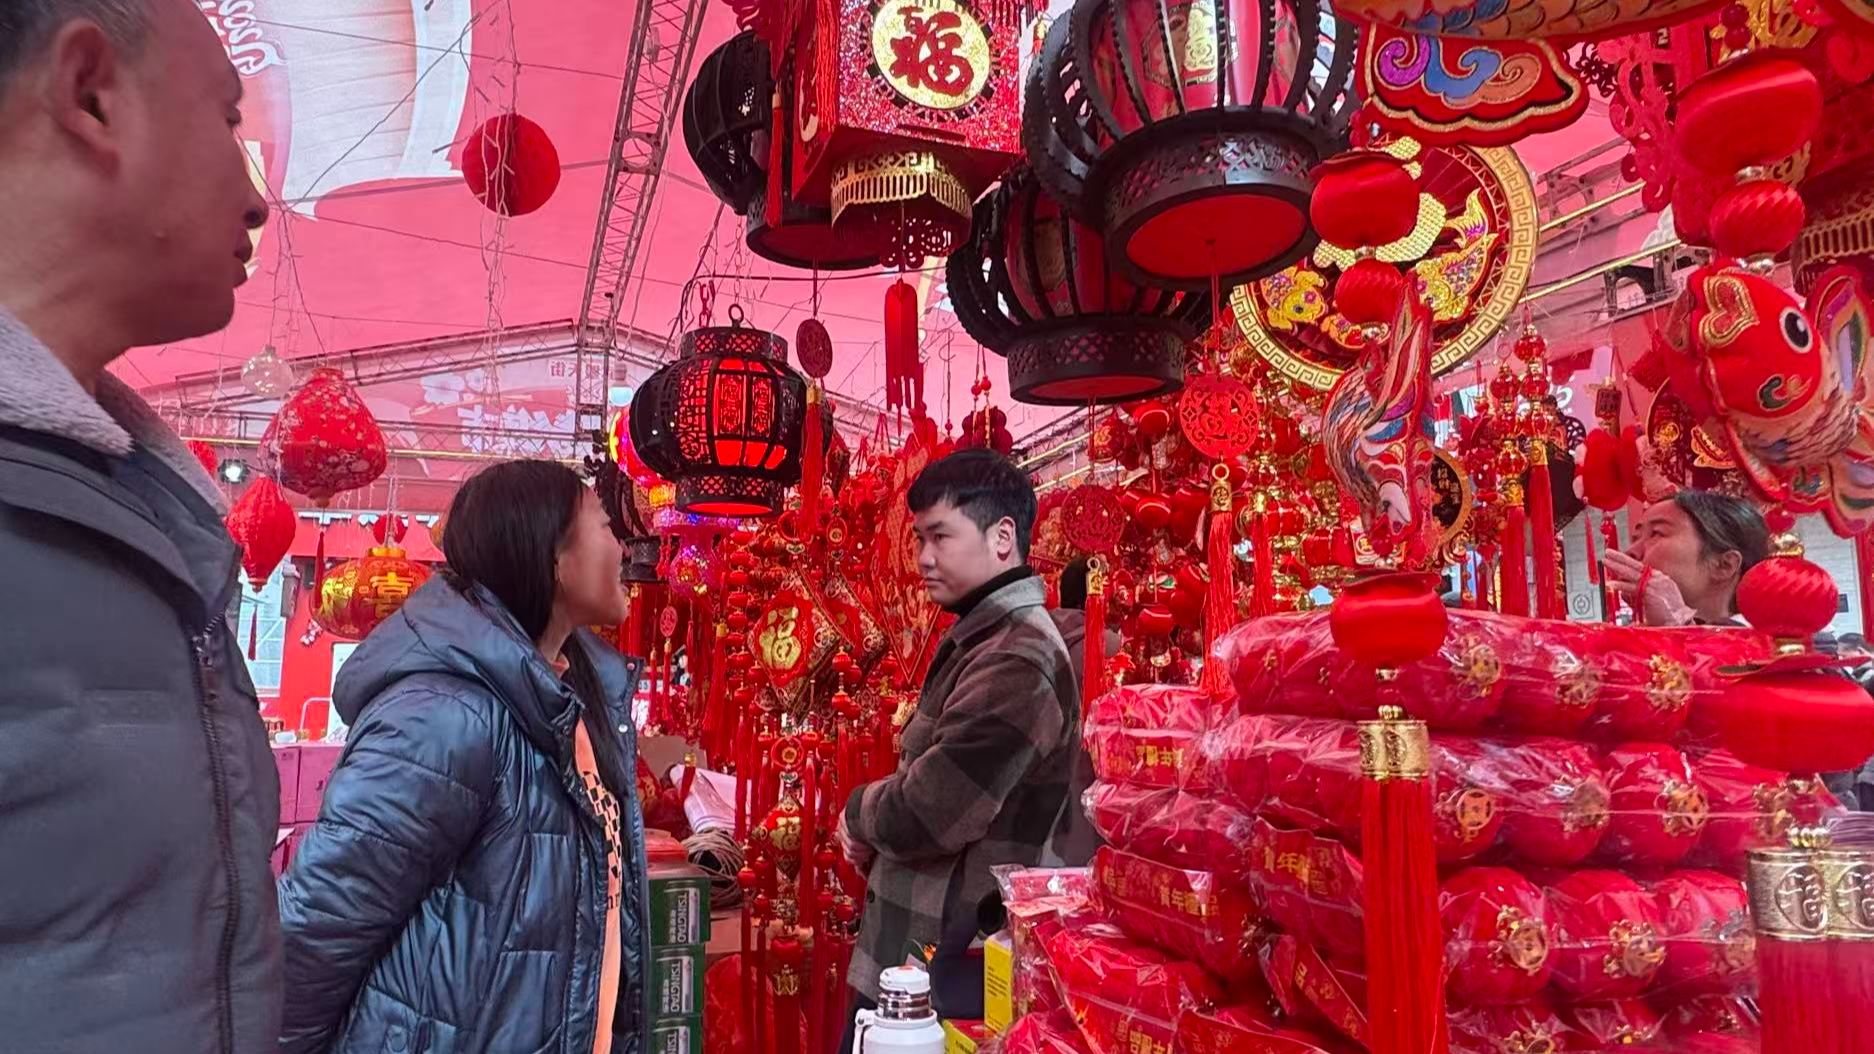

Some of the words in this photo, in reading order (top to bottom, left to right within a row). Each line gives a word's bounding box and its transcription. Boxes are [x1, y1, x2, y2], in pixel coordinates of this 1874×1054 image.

[888, 5, 975, 97] 福
[758, 606, 801, 670] 福
[677, 891, 688, 943] TSINGTAO
[670, 960, 681, 1012] TSINGTAO
